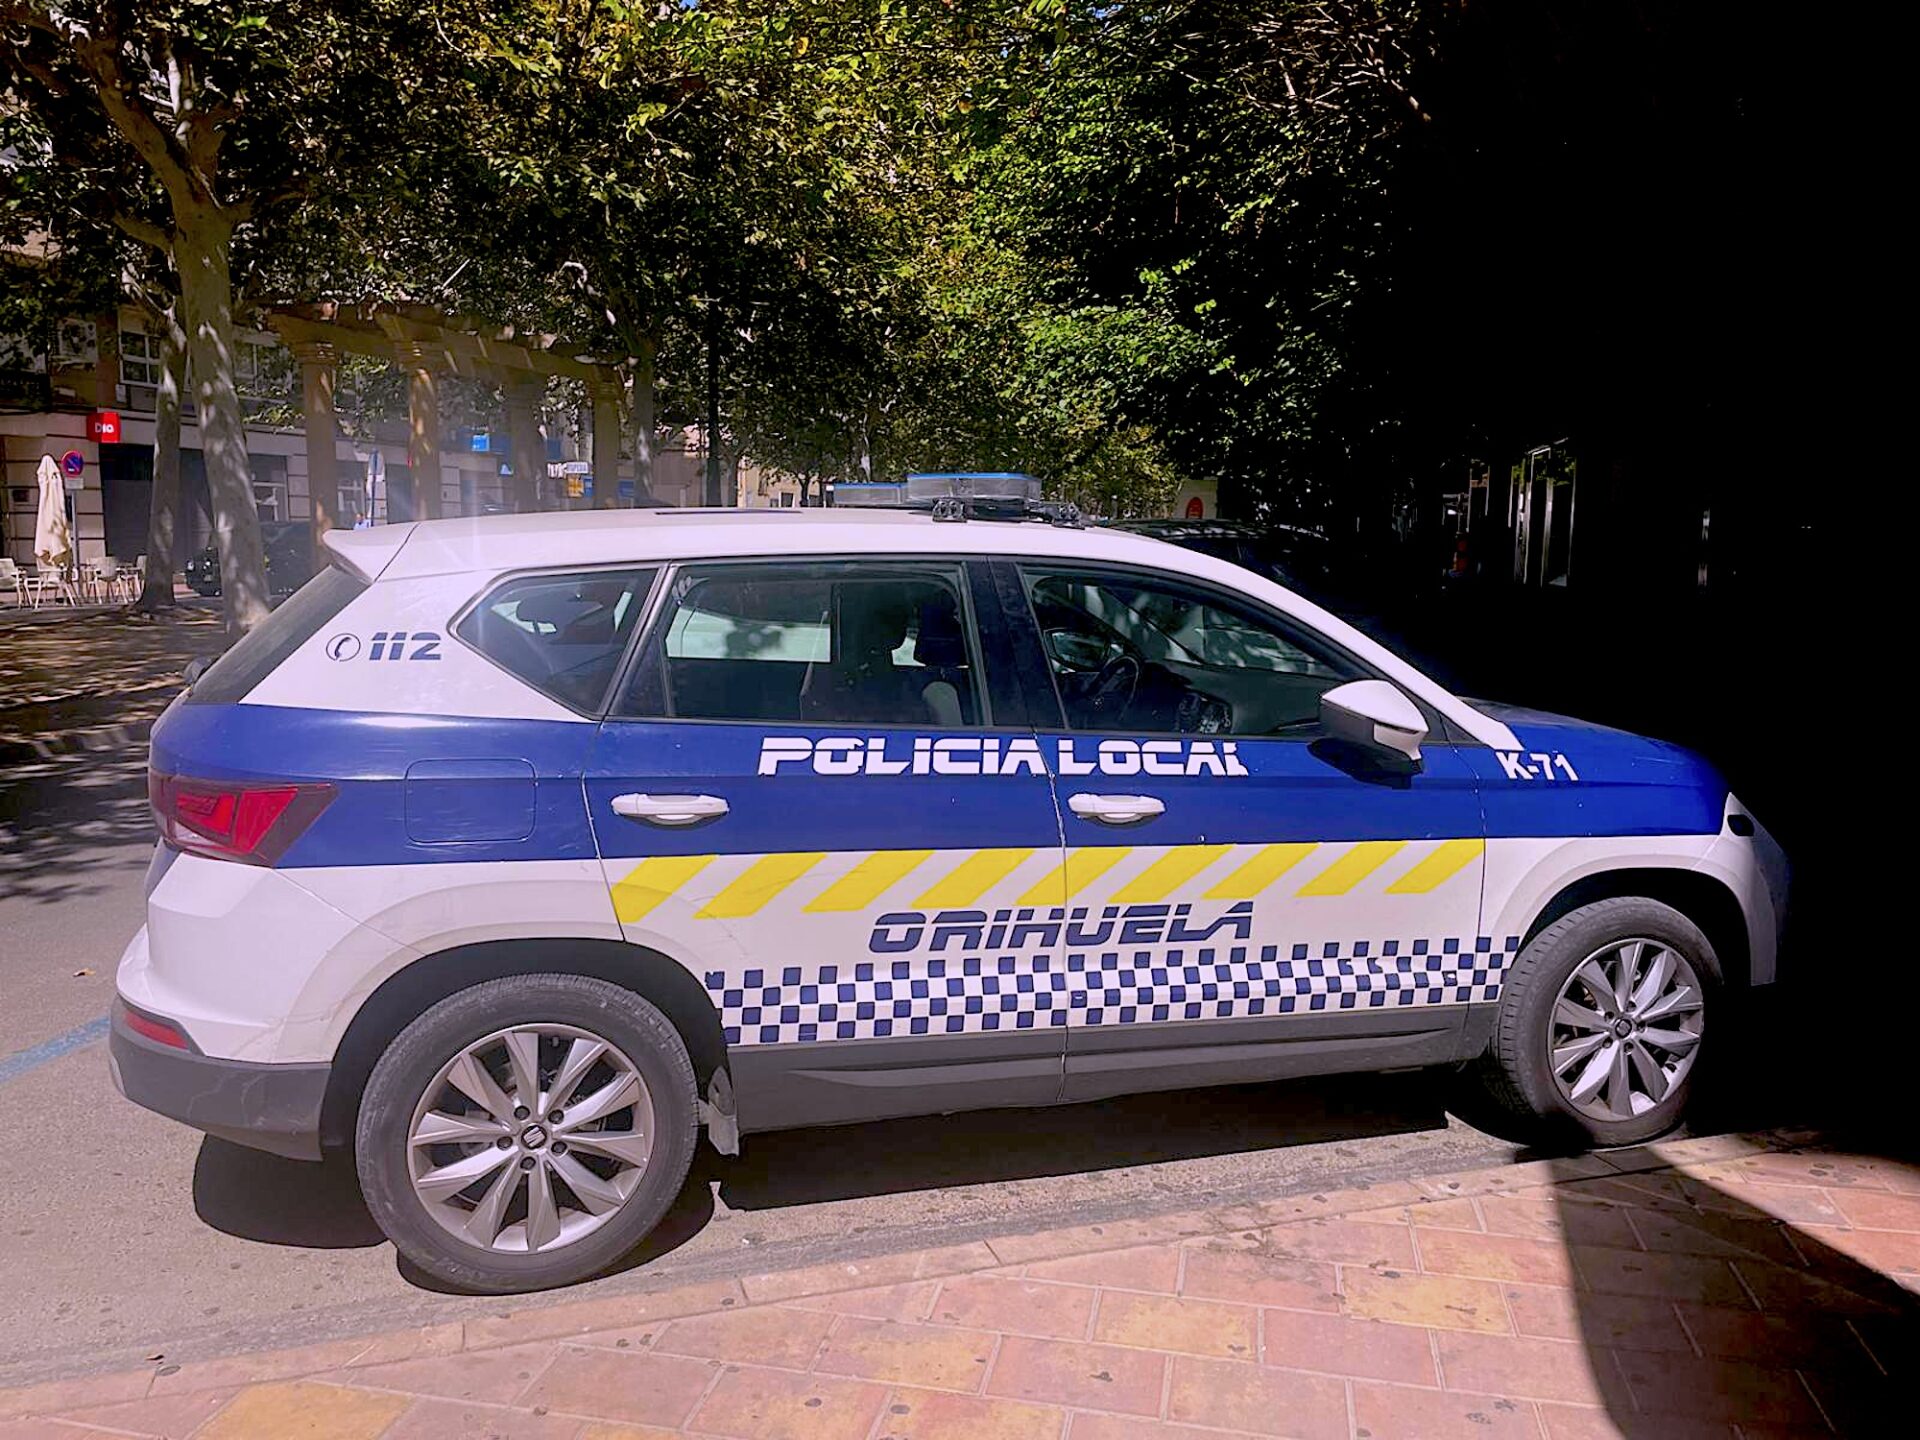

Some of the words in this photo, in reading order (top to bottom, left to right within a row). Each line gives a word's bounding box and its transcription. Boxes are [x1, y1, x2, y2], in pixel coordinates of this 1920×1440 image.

[369, 632, 442, 661] 112
[758, 737, 1047, 775] POLICIA
[1058, 739, 1249, 776] LOCAL
[1495, 751, 1579, 781] K-71
[869, 902, 1254, 953] ORIHUELA
